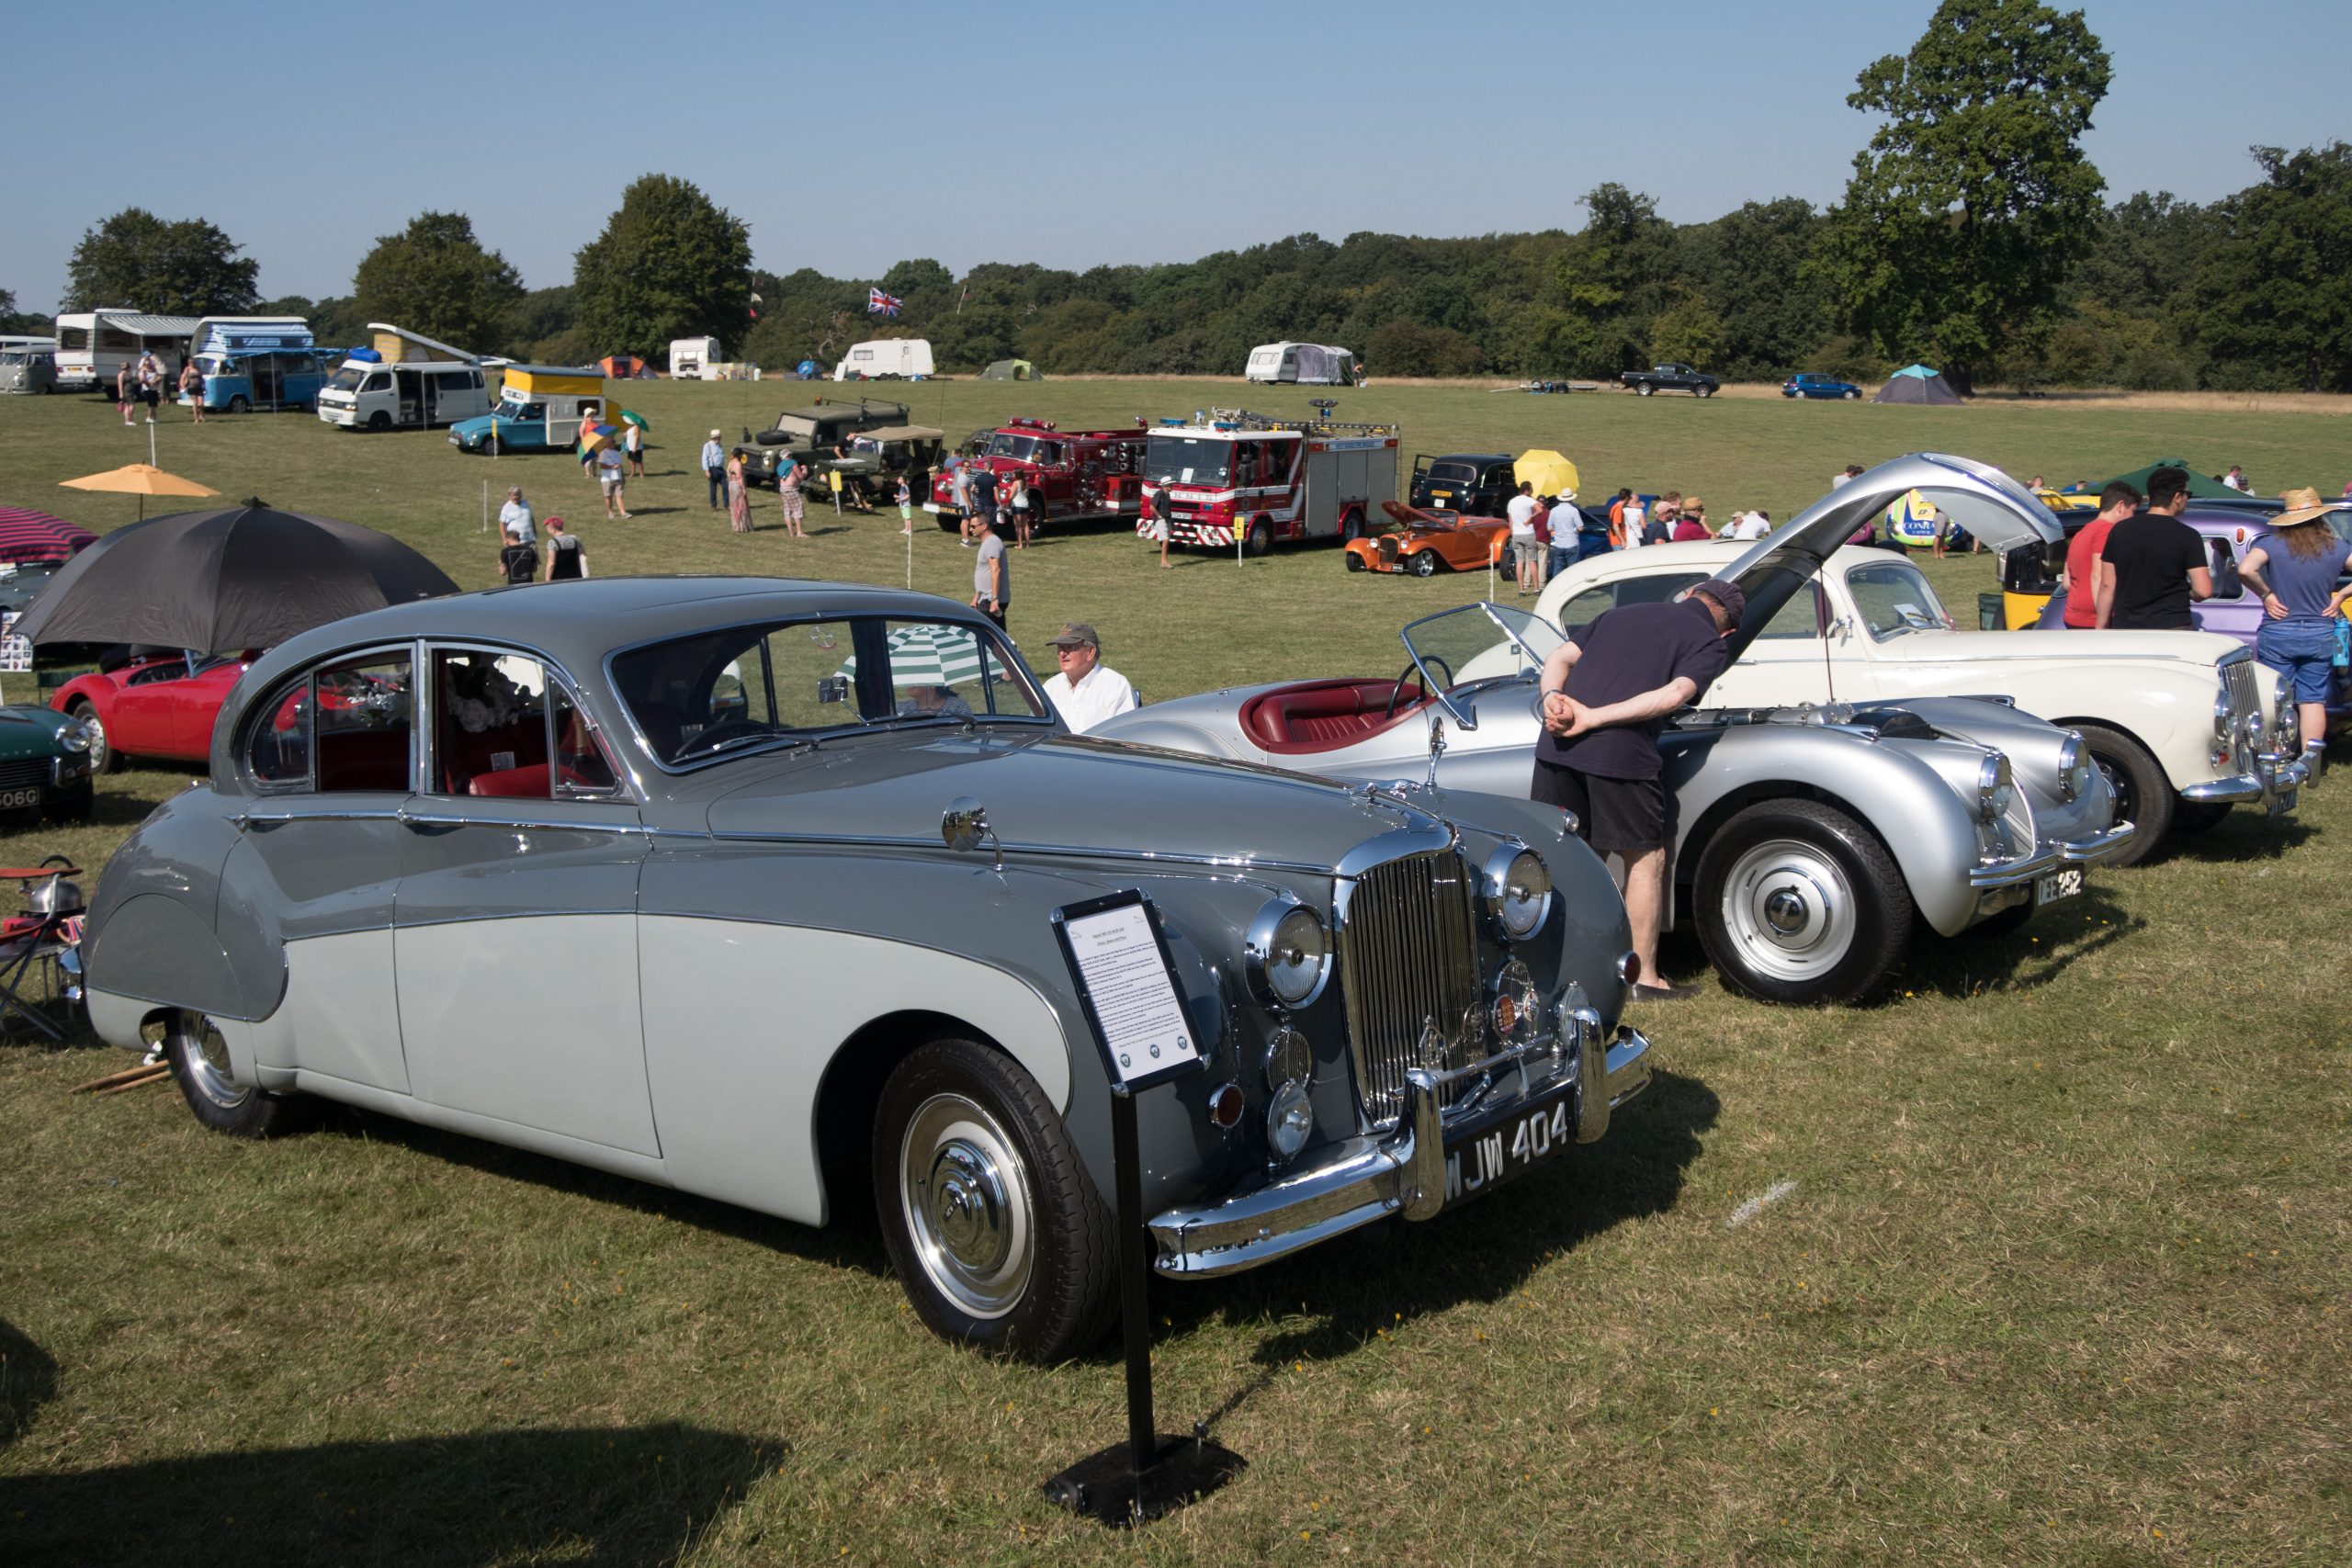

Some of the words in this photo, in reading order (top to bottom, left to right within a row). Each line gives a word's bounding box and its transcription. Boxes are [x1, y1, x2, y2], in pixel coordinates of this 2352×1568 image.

[1904, 521, 1935, 530] CONRA
[0, 789, 37, 807] 06G
[2058, 870, 2081, 899] 252
[1511, 1101, 1567, 1165] 404
